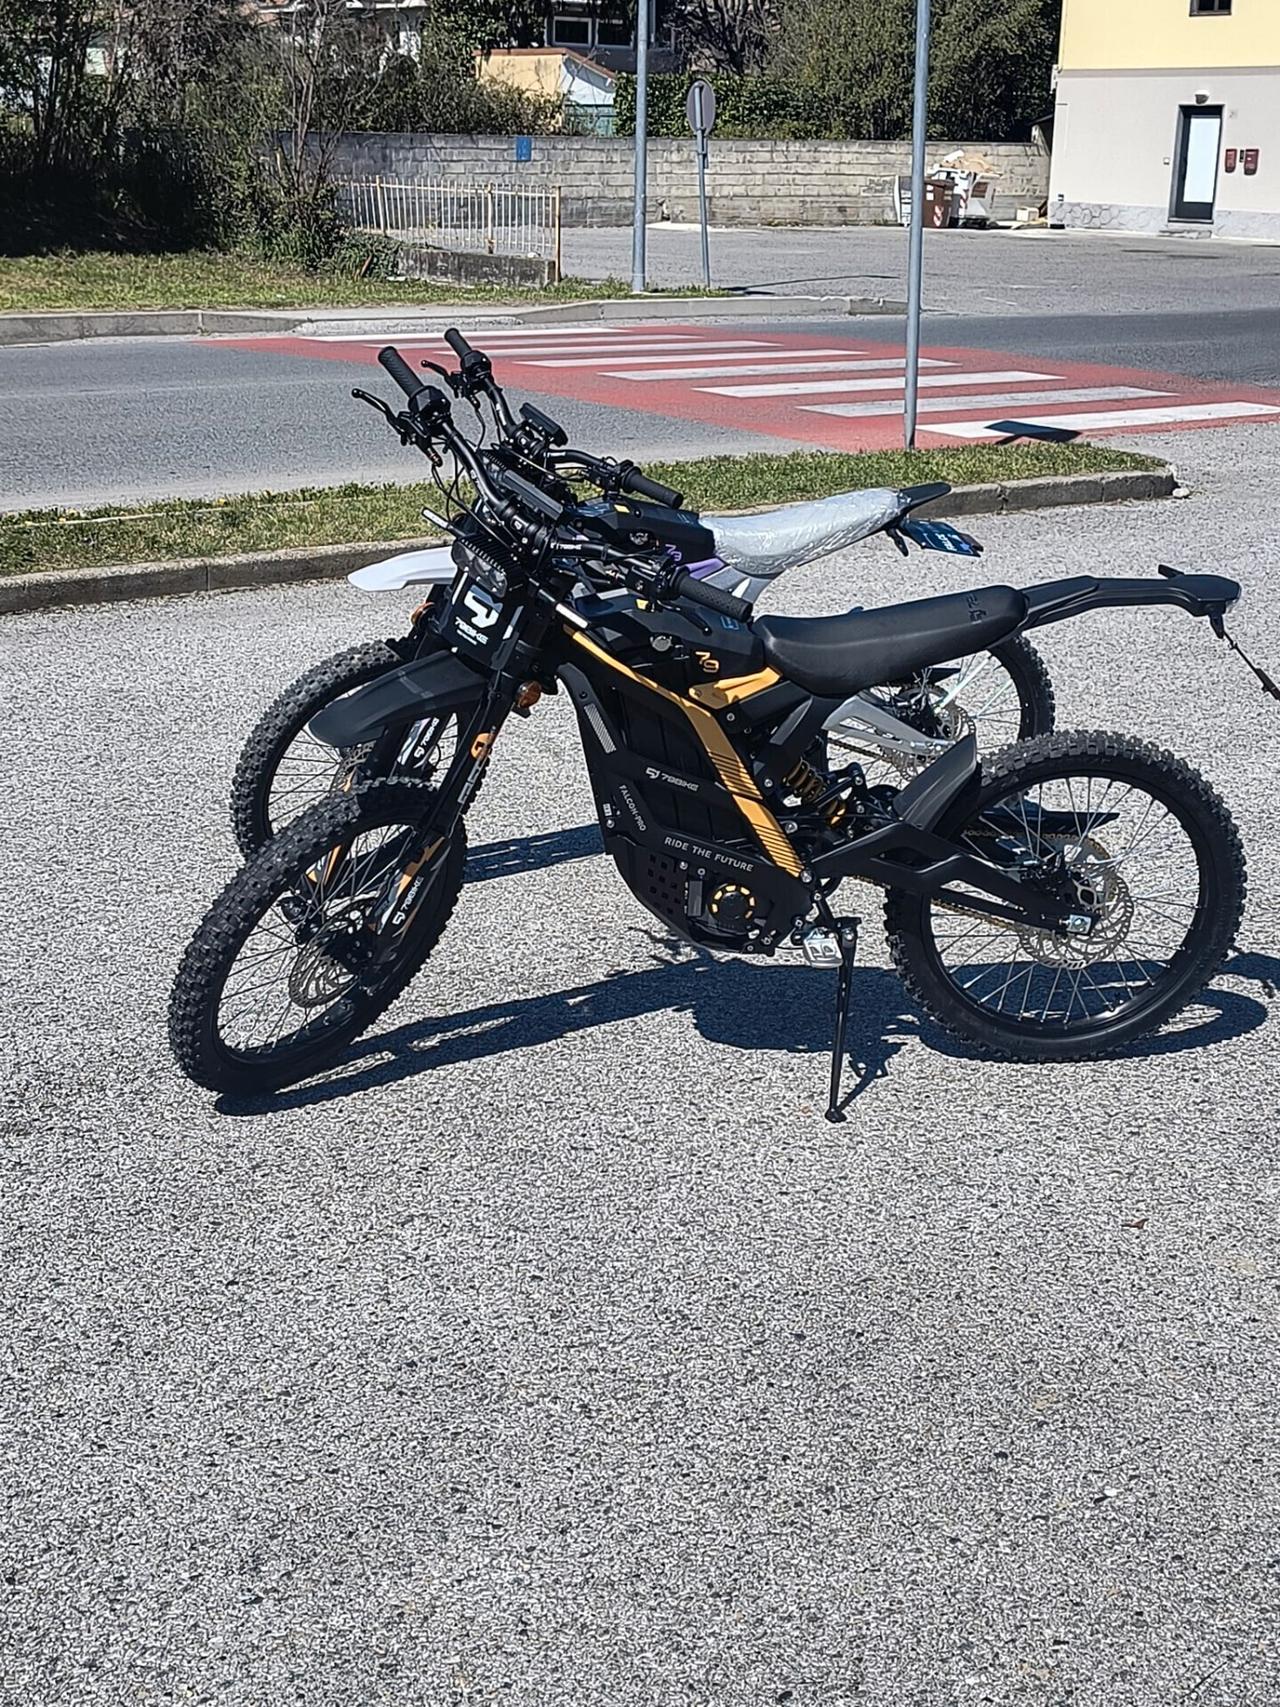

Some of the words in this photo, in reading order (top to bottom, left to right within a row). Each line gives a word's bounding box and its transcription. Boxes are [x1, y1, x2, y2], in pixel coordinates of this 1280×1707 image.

[695, 651, 720, 673] 79
[619, 784, 647, 831] FALCON-PRO
[664, 836, 689, 851] RIDE
[692, 845, 712, 859] THE
[714, 854, 754, 872] FUTURE
